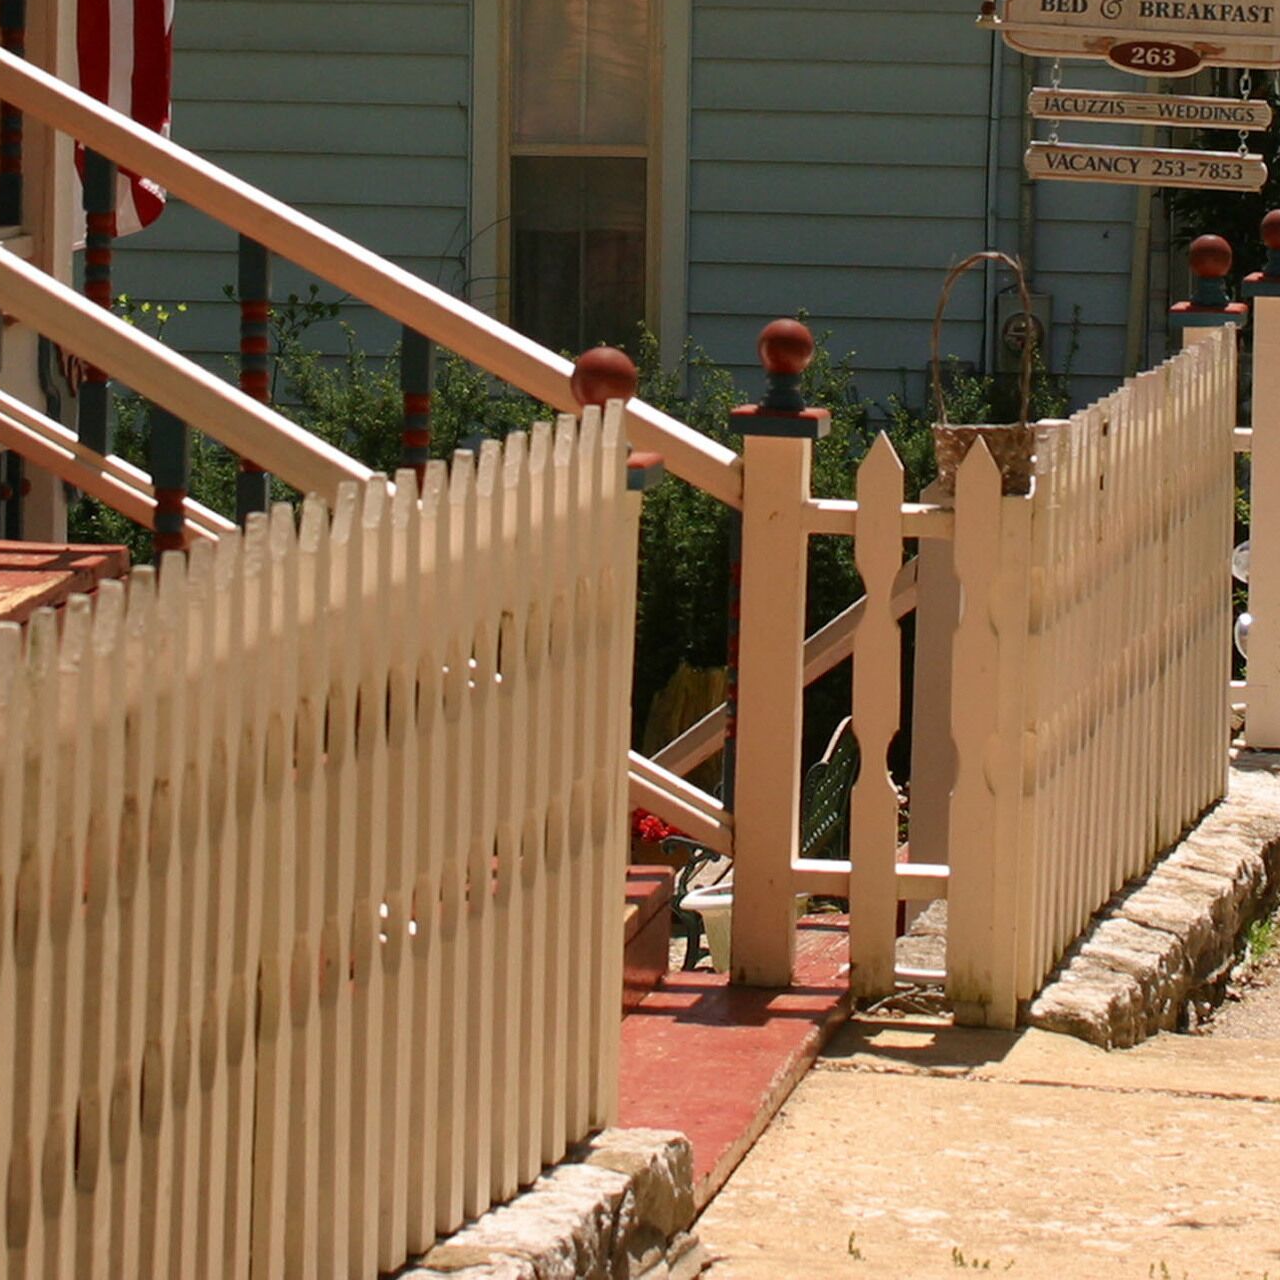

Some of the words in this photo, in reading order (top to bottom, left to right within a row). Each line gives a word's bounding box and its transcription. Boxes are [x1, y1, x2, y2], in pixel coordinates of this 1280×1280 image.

[1139, 0, 1274, 23] BREAKFAST
[1131, 47, 1175, 66] 263
[1043, 95, 1124, 115] JACUZZIS
[1157, 103, 1255, 122] WEDDINGS
[1045, 153, 1140, 175] VACANCY
[1152, 158, 1243, 180] 253-7853
